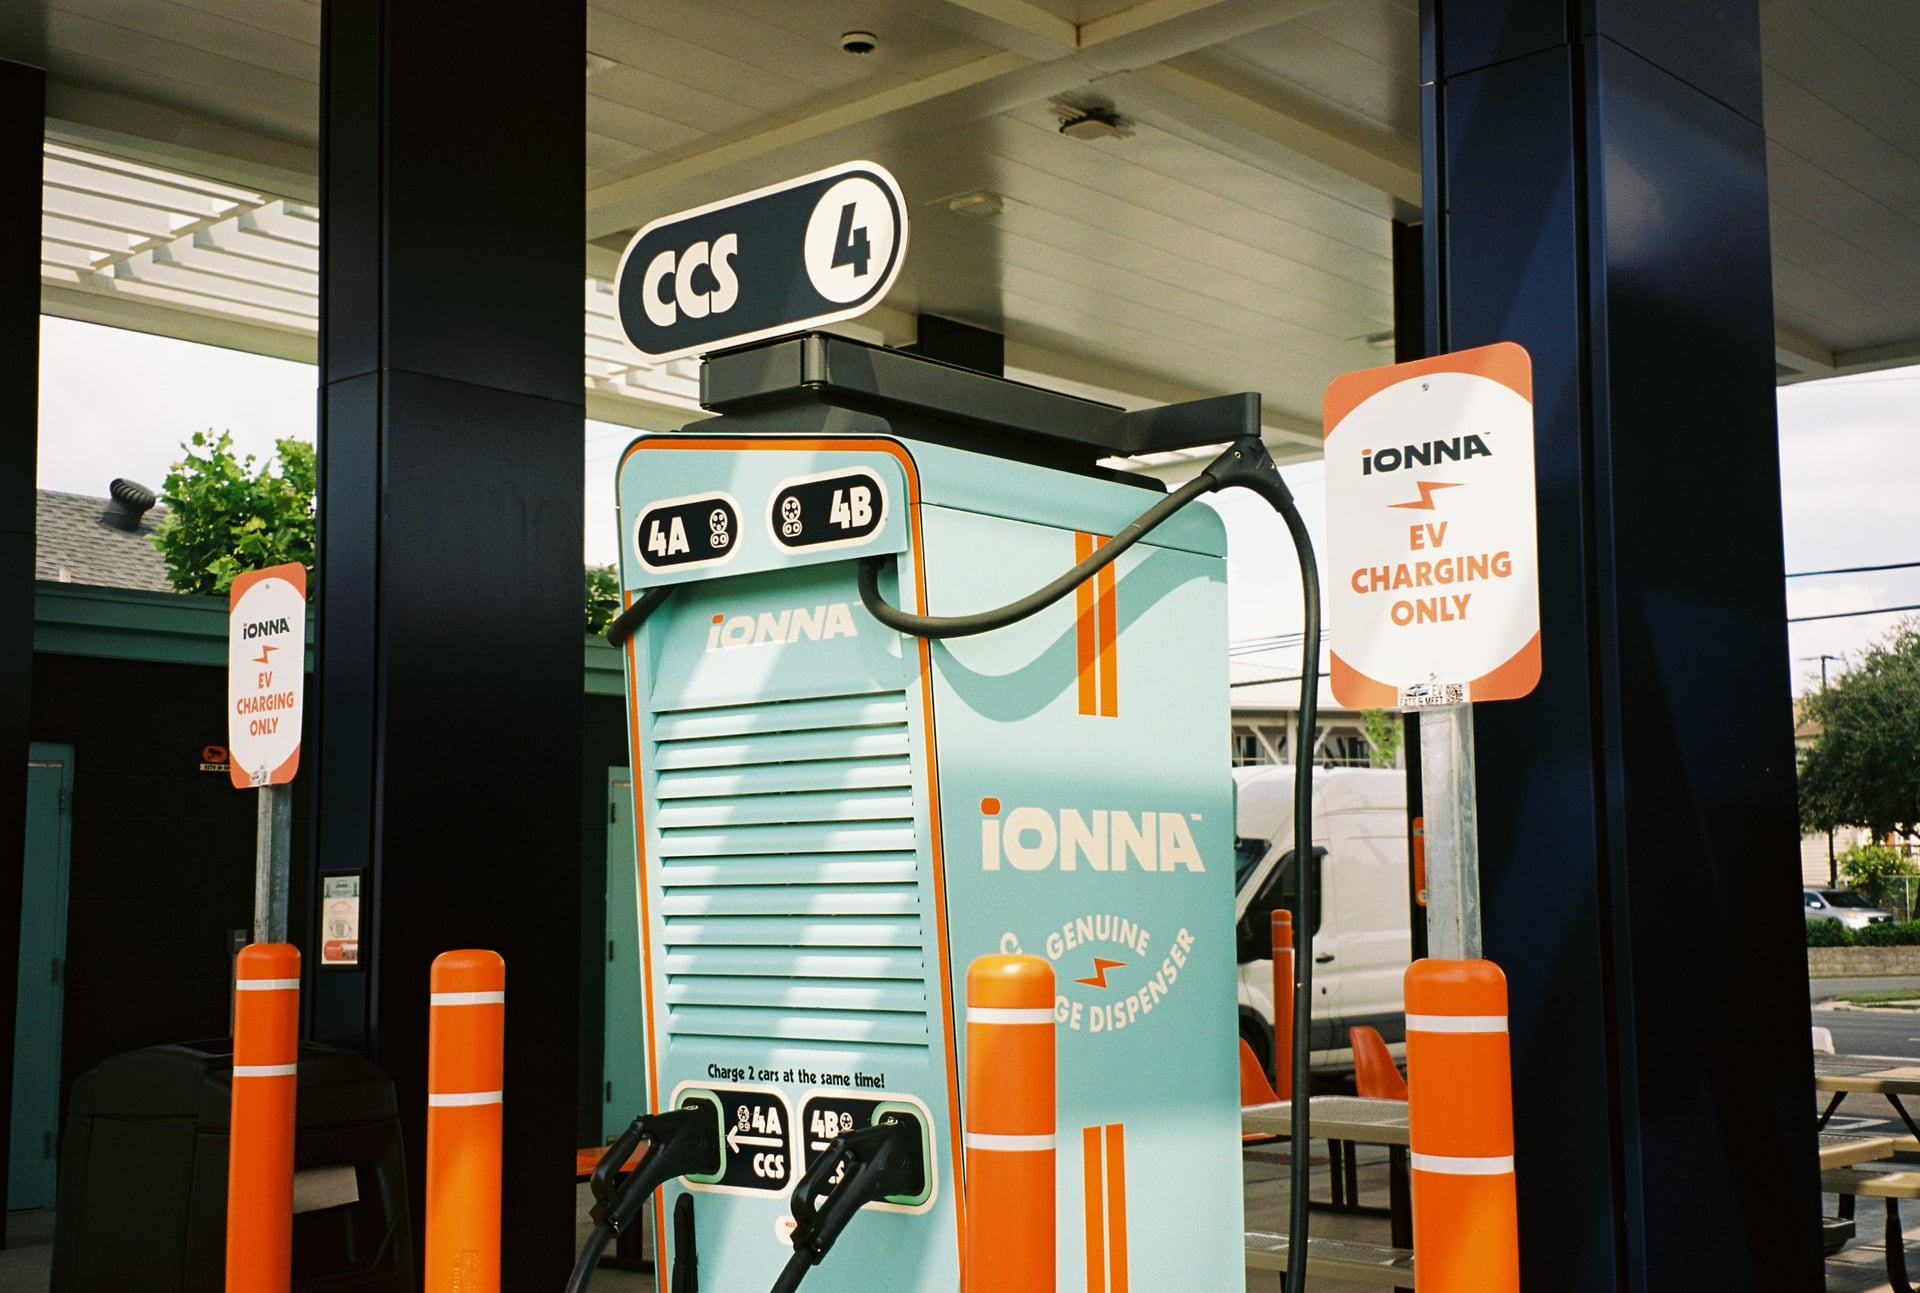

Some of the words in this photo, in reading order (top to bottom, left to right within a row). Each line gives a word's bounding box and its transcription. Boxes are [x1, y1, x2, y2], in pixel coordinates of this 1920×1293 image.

[642, 233, 738, 327] CCS
[831, 201, 871, 278] 4
[829, 486, 873, 529] 4B
[648, 516, 690, 557] 4A
[1409, 521, 1448, 550] EV
[1351, 551, 1512, 594] CHARGING
[1391, 594, 1472, 626] ONLY
[258, 671, 272, 689] EV
[236, 691, 294, 715] CHARGING
[249, 717, 279, 736] ONLY
[1046, 914, 1151, 961] GENUINE
[1089, 927, 1195, 1033] DISPENSER
[708, 1063, 745, 1082] Charge
[748, 1066, 755, 1080] 2
[758, 1069, 779, 1082] cars
[783, 1068, 795, 1083] at
[798, 1069, 817, 1084] the
[821, 1074, 851, 1087] same
[854, 1072, 885, 1088] time!
[751, 1106, 782, 1135] 4A
[810, 1110, 839, 1139] 4B
[753, 1153, 785, 1180] CCS
